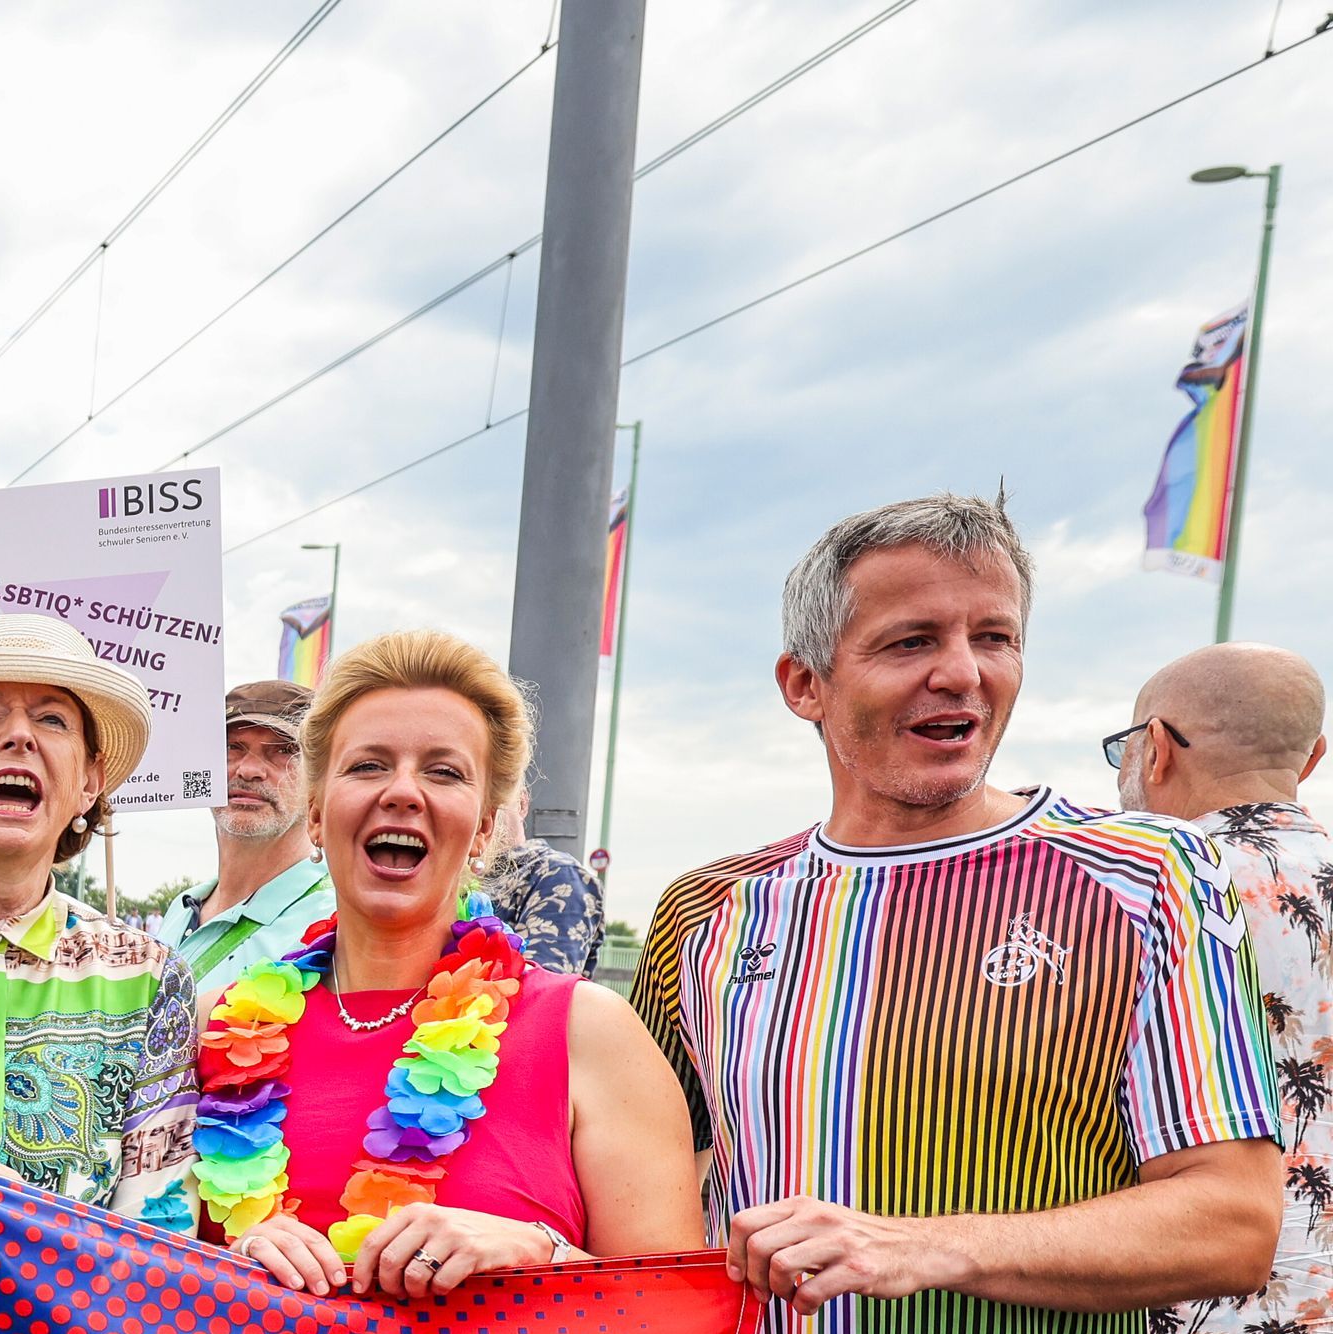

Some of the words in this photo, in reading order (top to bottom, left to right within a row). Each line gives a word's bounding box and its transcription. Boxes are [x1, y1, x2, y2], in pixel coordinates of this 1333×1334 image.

[123, 479, 203, 517] BISS
[98, 519, 212, 536] Bundesinteressenvertretung
[98, 537, 135, 547] schwuler
[136, 533, 172, 544] Senioren
[182, 532, 189, 540] V.
[87, 600, 222, 645] SCHÜTZEN!
[81, 632, 166, 671] NZUNG
[728, 968, 776, 984] hummel
